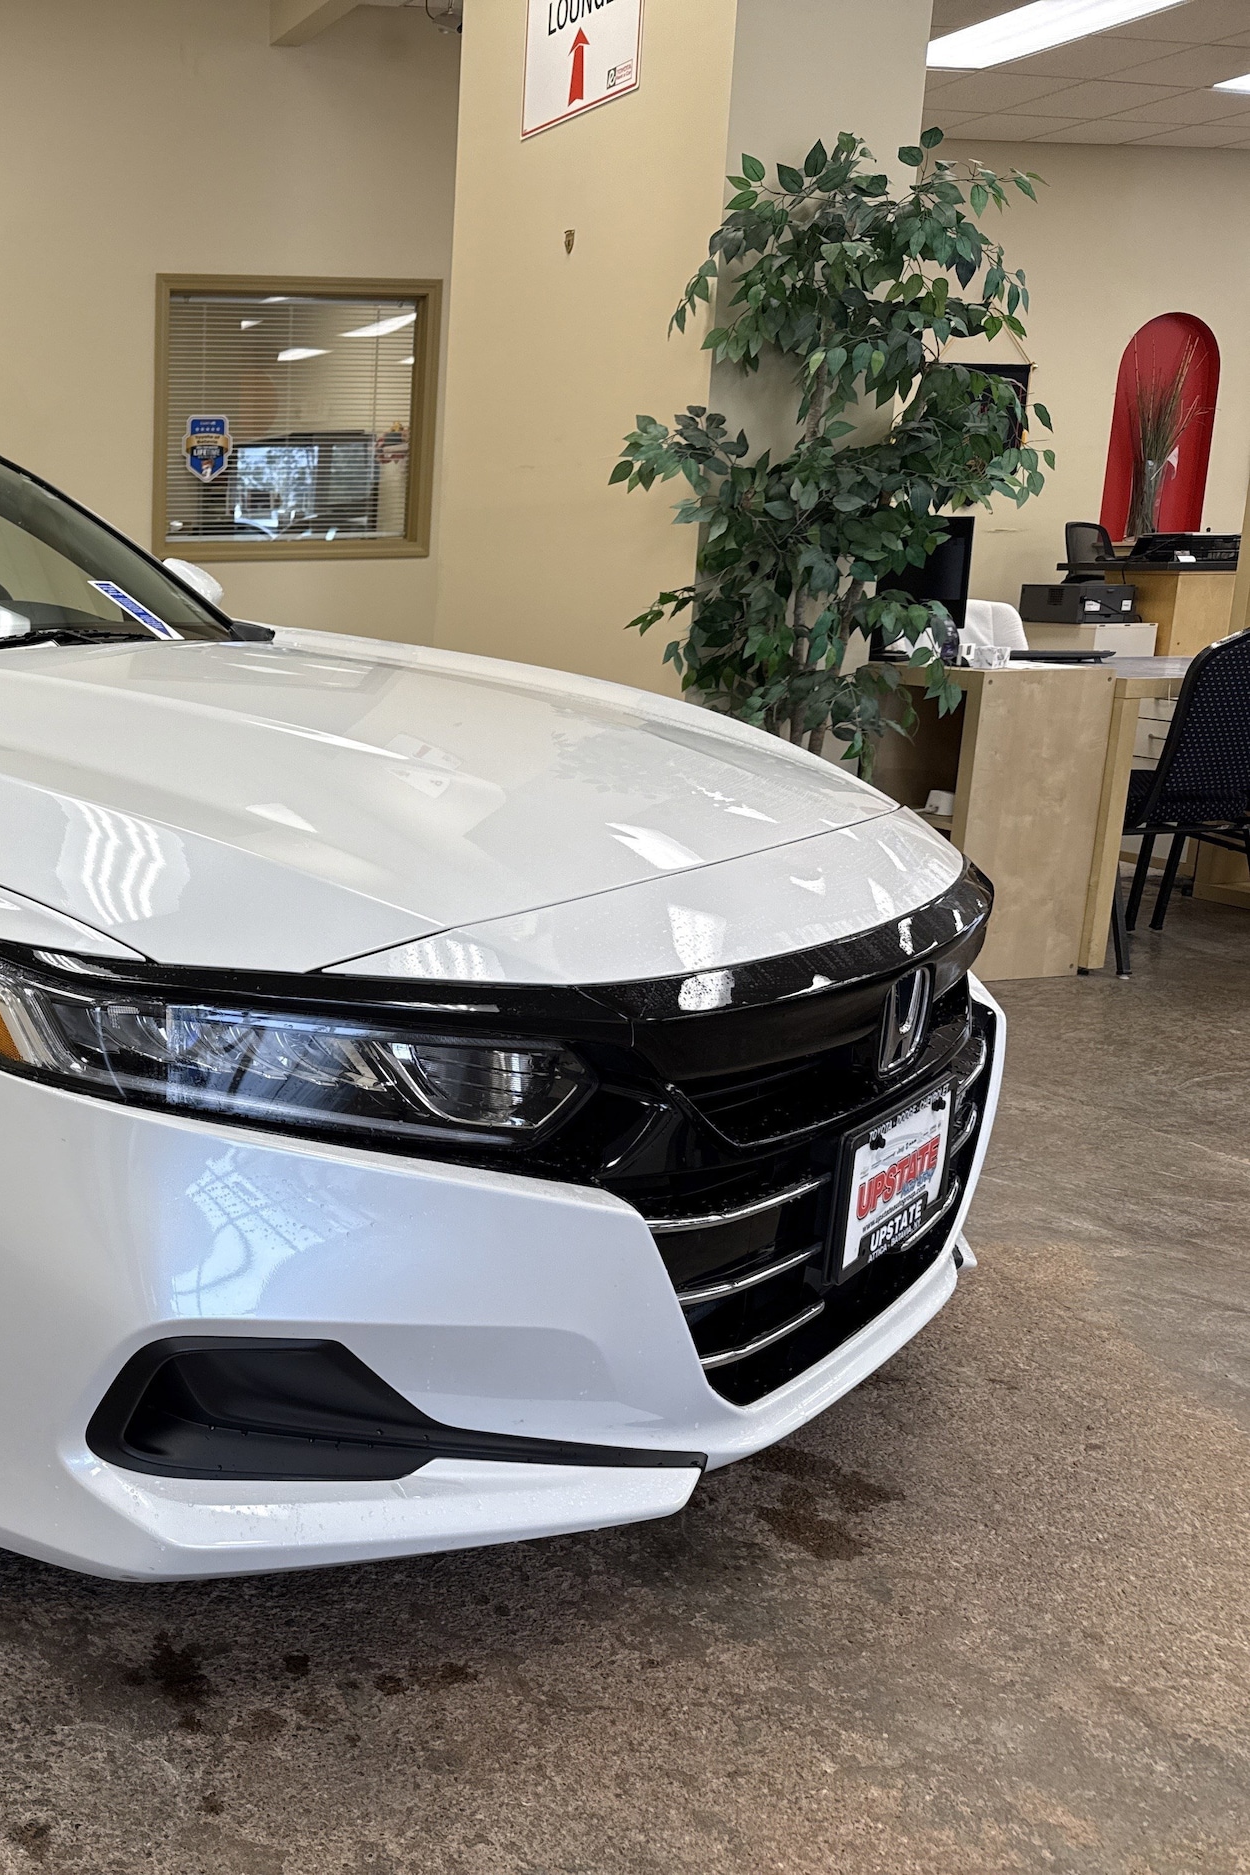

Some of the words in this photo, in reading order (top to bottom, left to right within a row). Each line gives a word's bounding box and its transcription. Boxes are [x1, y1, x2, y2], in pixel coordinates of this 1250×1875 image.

[548, 0, 613, 36] LOUN
[857, 1134, 941, 1221] UPSTATE
[870, 1199, 922, 1252] UPSTATE
